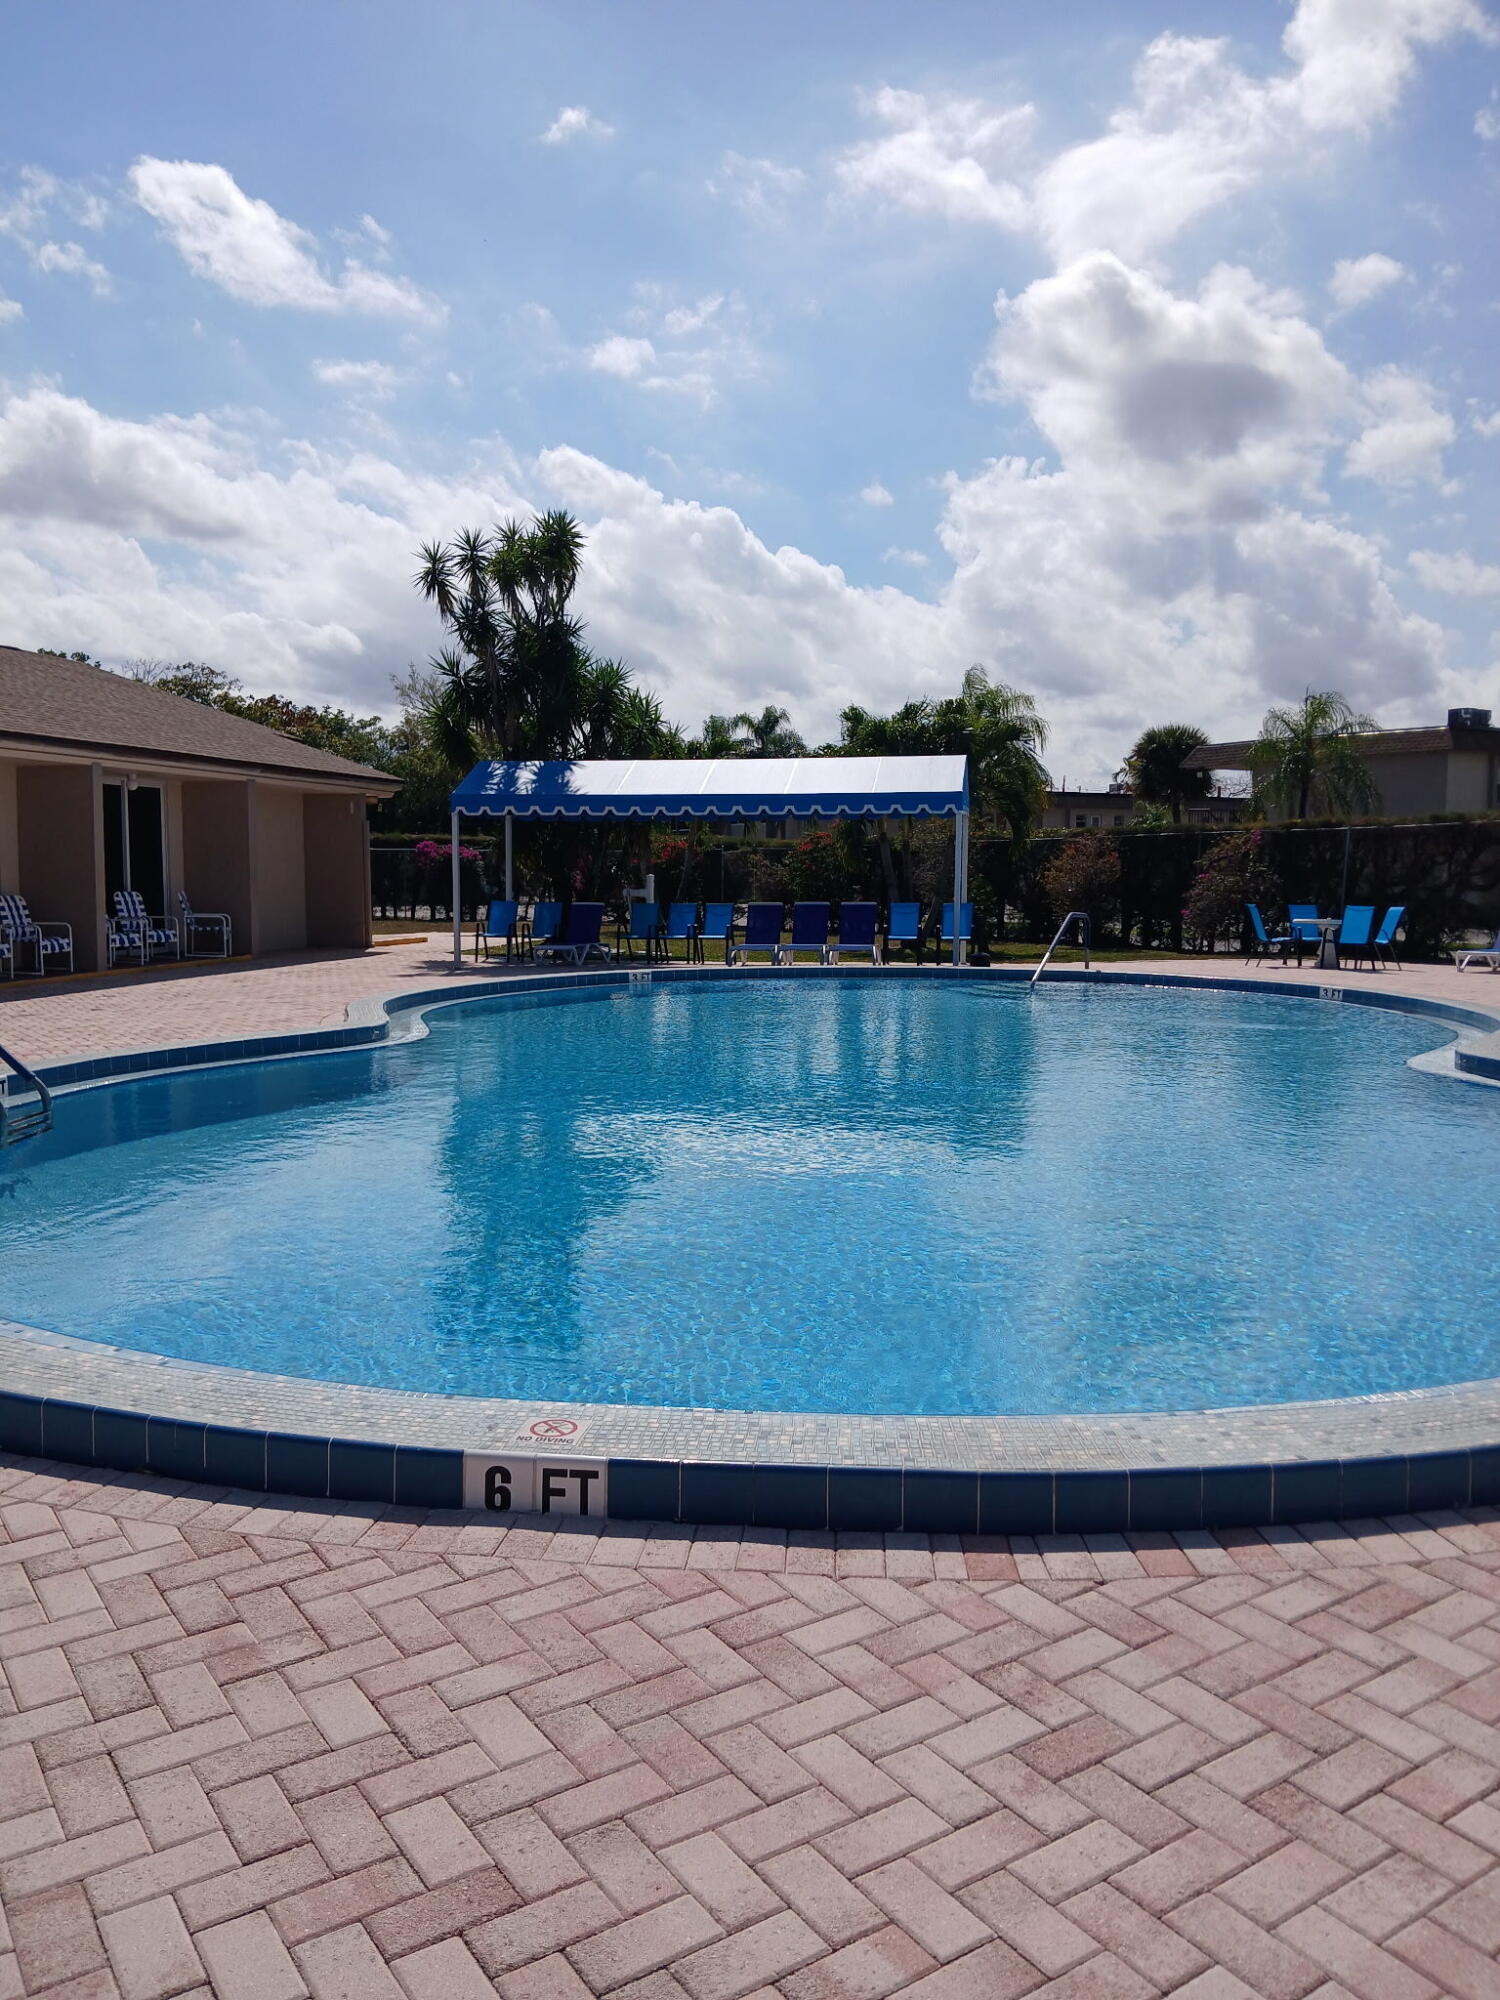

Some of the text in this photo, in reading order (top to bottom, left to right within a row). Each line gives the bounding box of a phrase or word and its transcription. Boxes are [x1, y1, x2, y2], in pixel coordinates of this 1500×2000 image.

[1332, 989, 1342, 1000] FT
[484, 1465, 600, 1516] 6 FT
